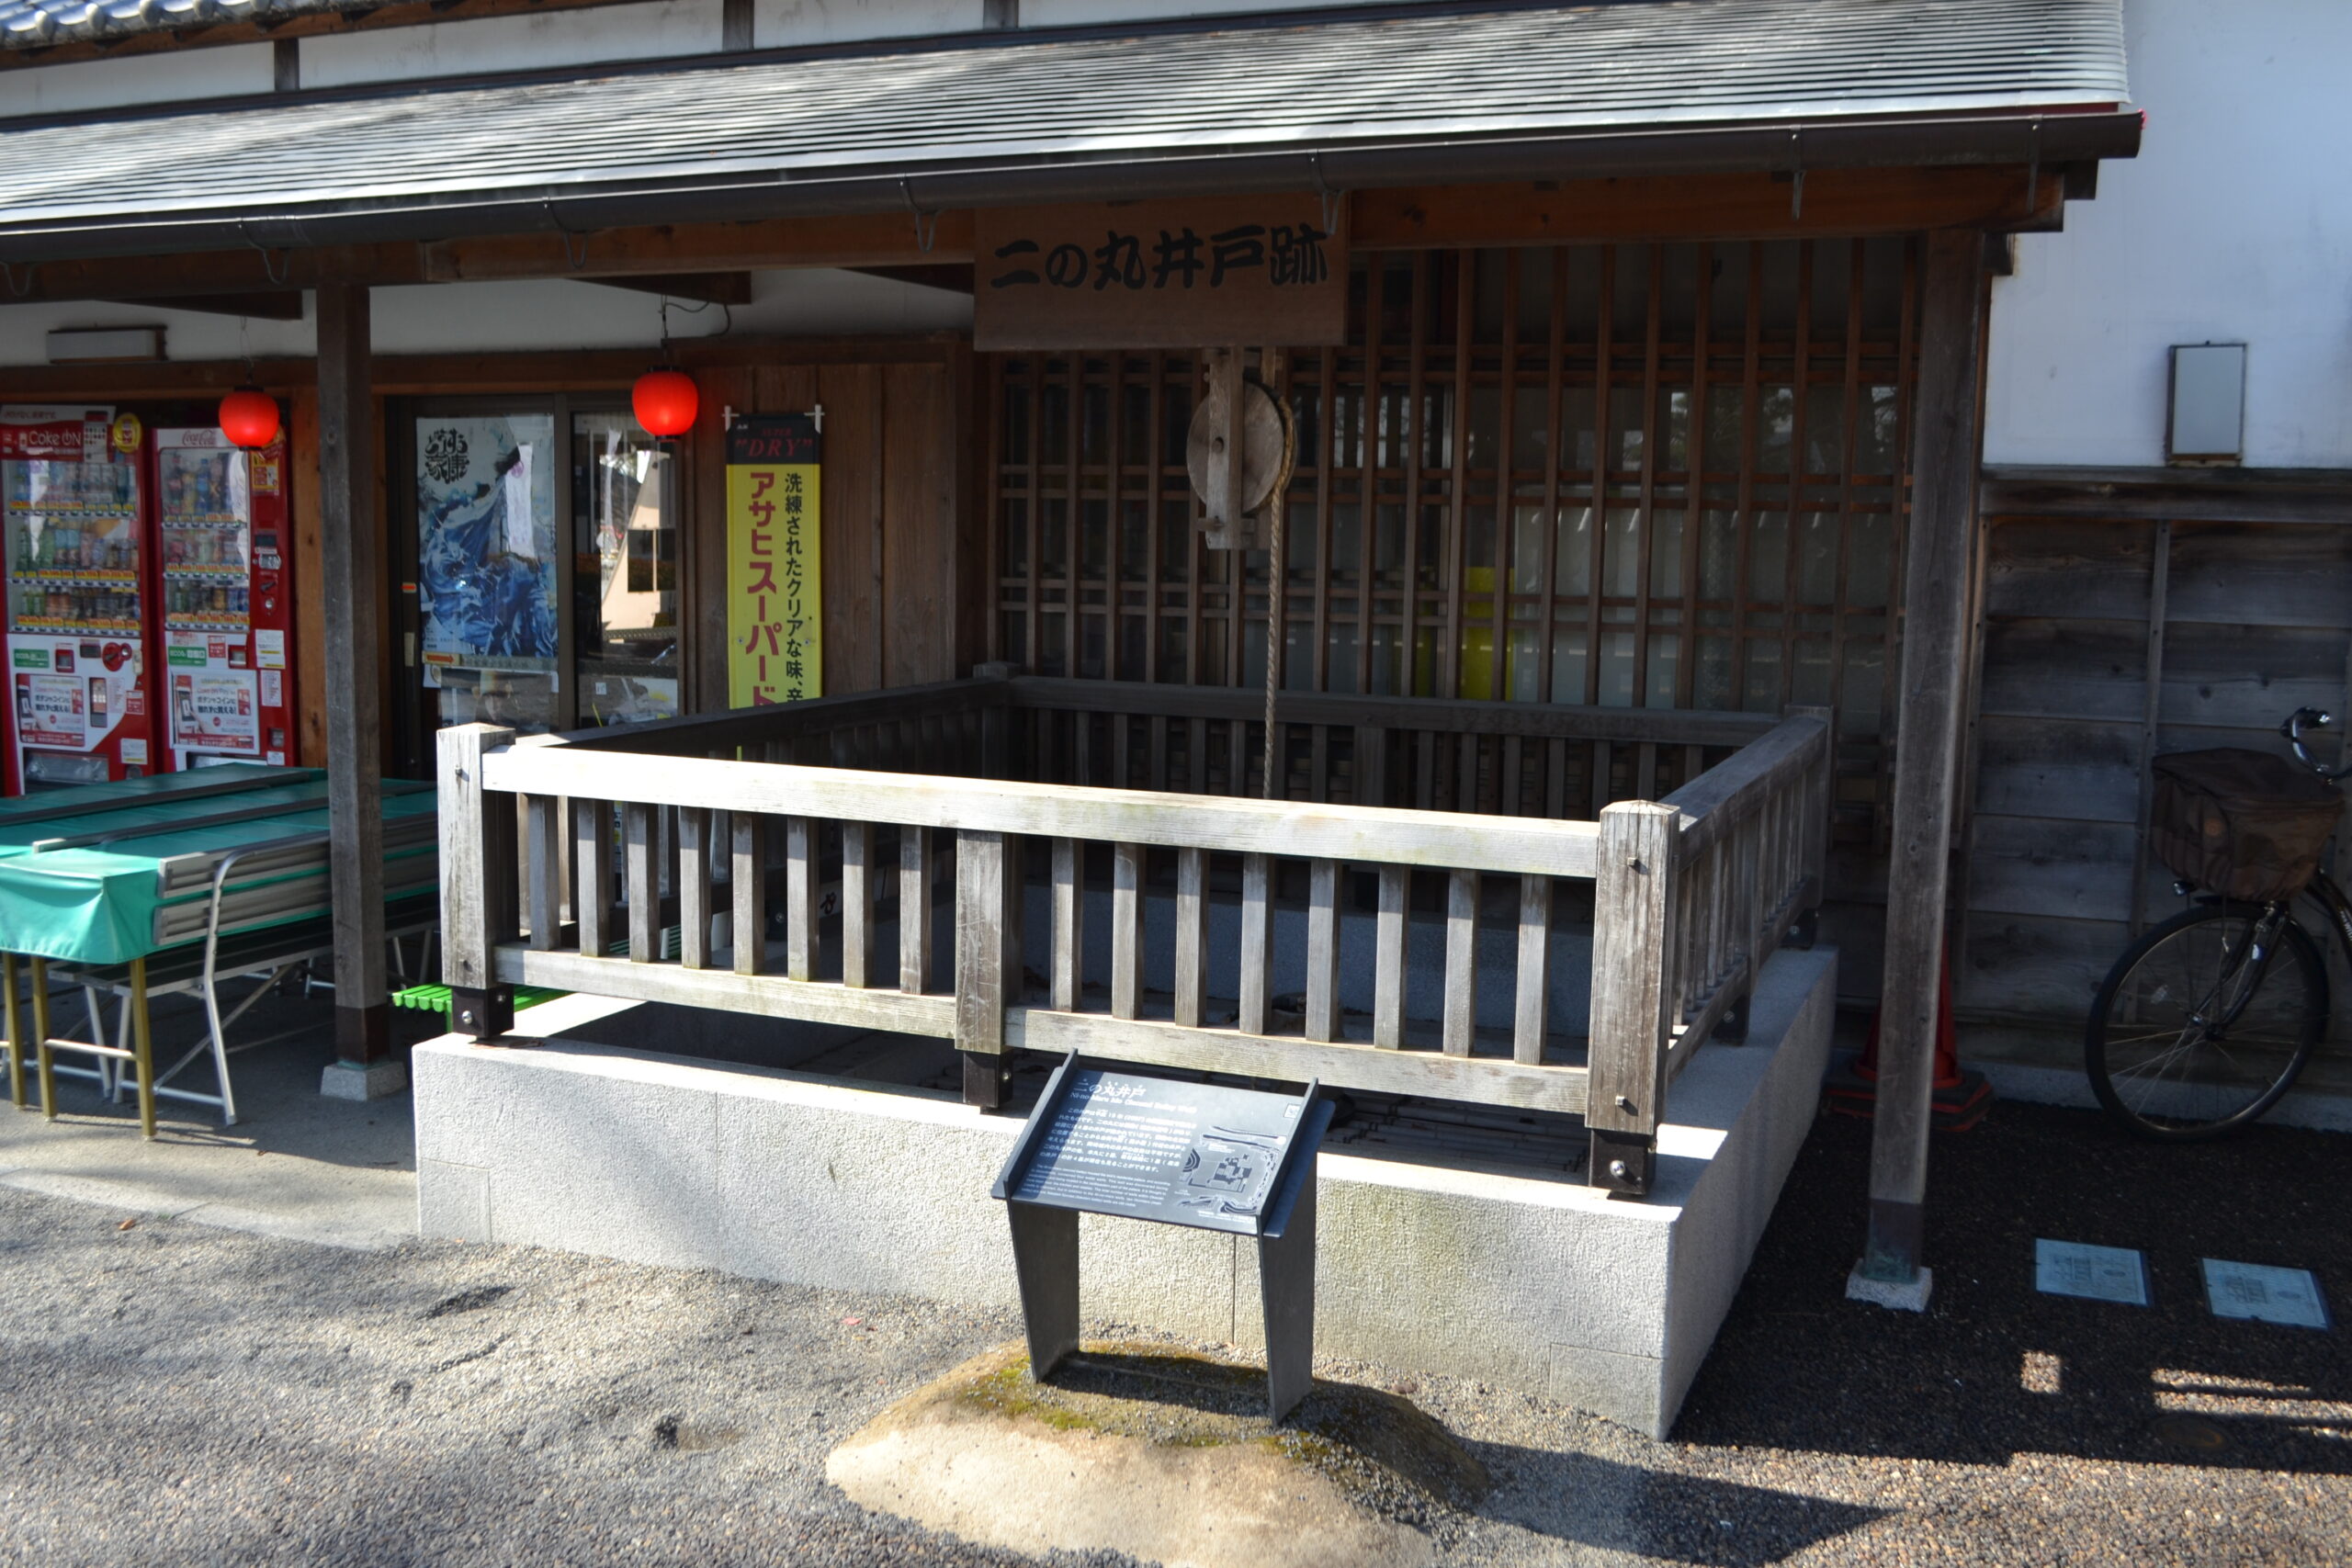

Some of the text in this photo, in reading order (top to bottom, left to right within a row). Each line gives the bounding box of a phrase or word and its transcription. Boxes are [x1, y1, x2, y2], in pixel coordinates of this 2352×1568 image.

[990, 222, 1330, 290] 二の丸井戸跡
[28, 430, 60, 446] Coke
[1072, 1079, 1147, 1099] 二の丸井戸
